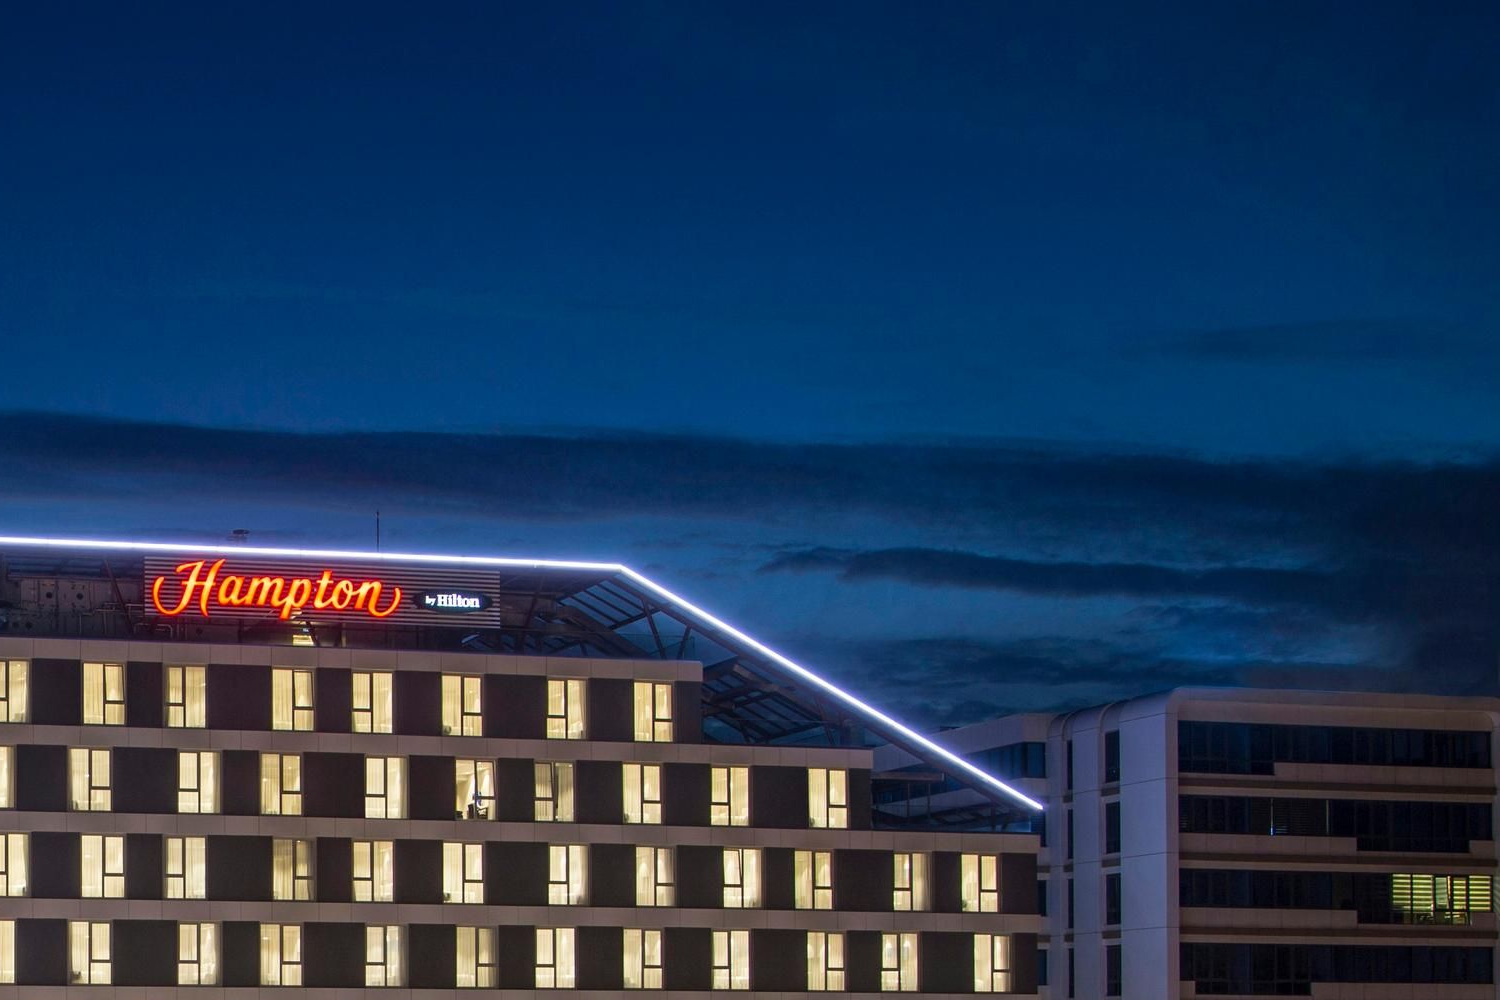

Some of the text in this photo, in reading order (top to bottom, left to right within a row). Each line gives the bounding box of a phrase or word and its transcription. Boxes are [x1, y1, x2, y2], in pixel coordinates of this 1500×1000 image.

[152, 557, 481, 621] Hampton by Hilton
